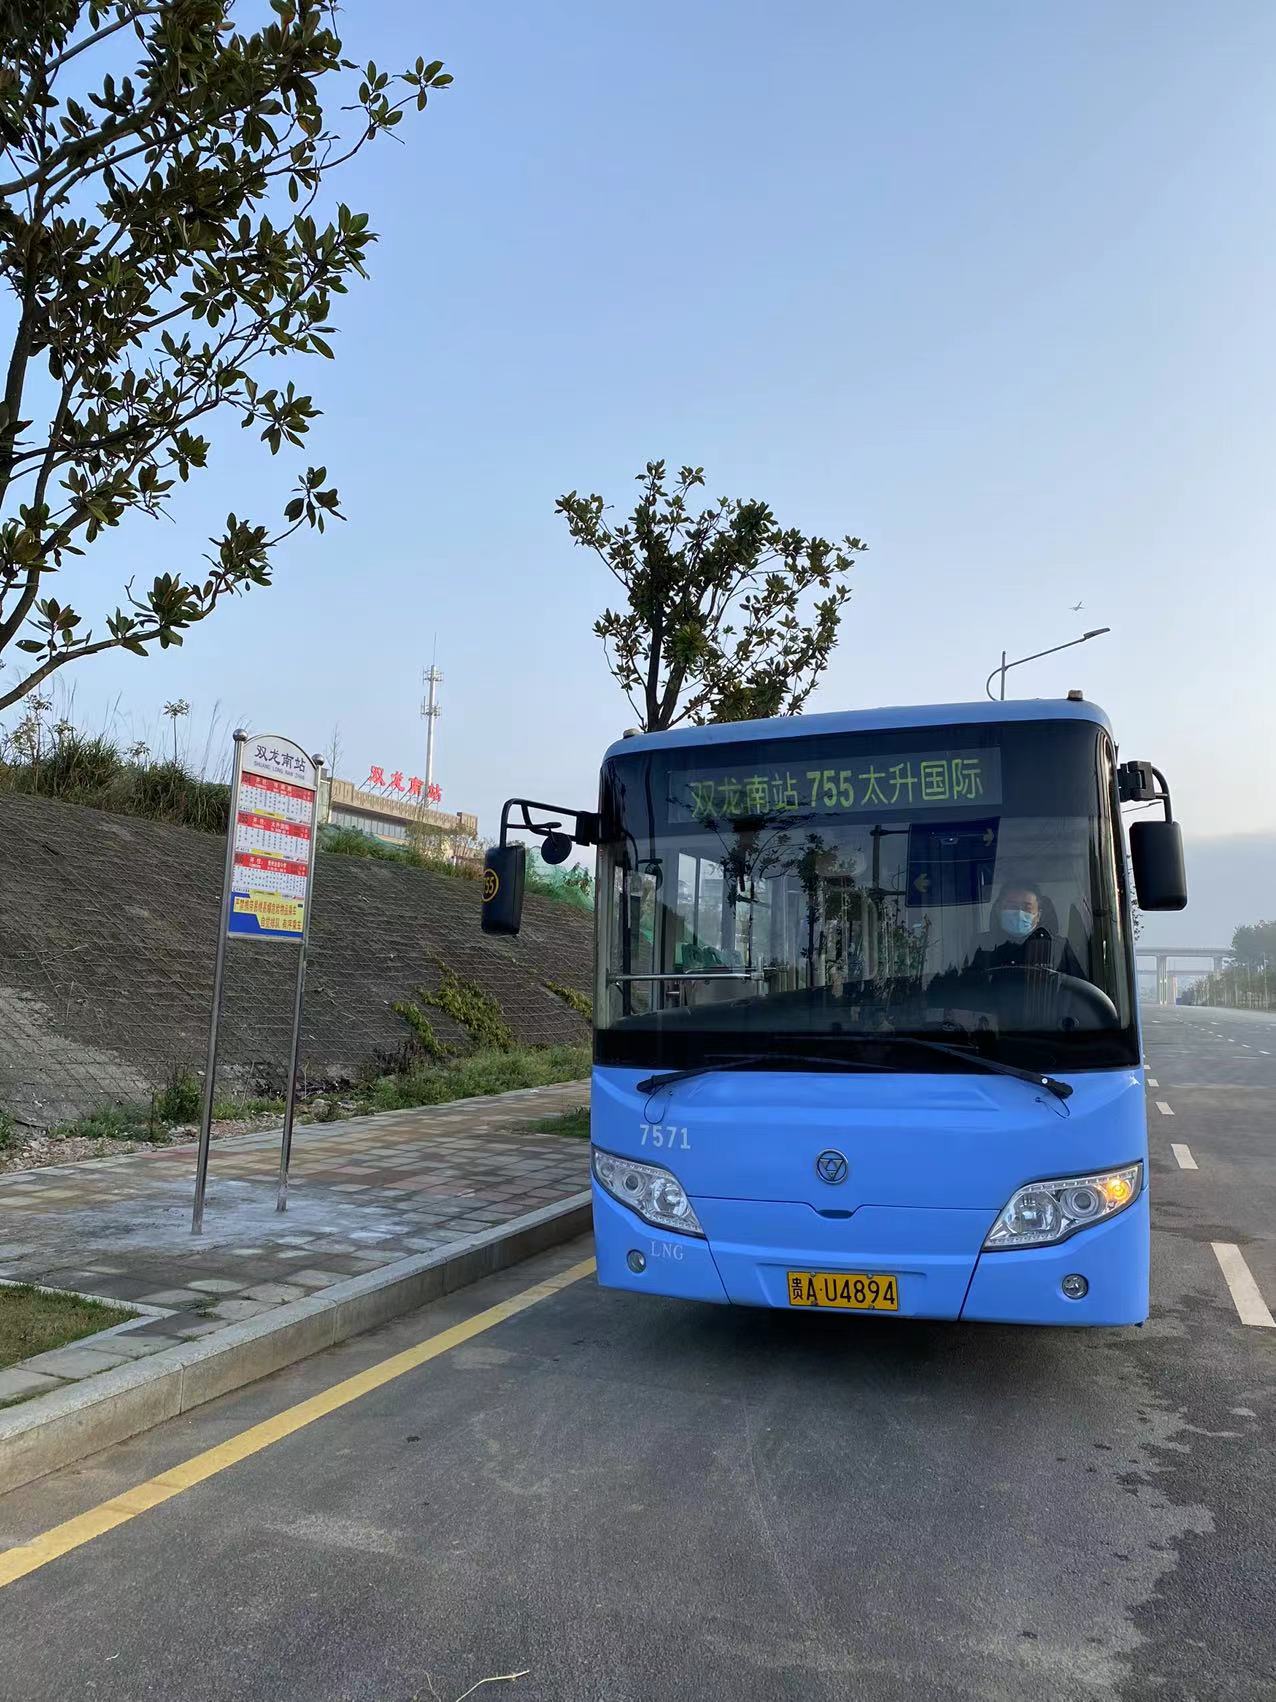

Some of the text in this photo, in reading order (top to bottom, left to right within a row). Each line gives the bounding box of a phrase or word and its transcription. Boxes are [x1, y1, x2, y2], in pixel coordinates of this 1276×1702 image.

[254, 744, 306, 772] 双龙南站
[368, 765, 442, 802] 双龙南站
[689, 758, 983, 818] 双龙南站 755 太升国际
[640, 1124, 691, 1150] 7571
[650, 1241, 684, 1261] LNG
